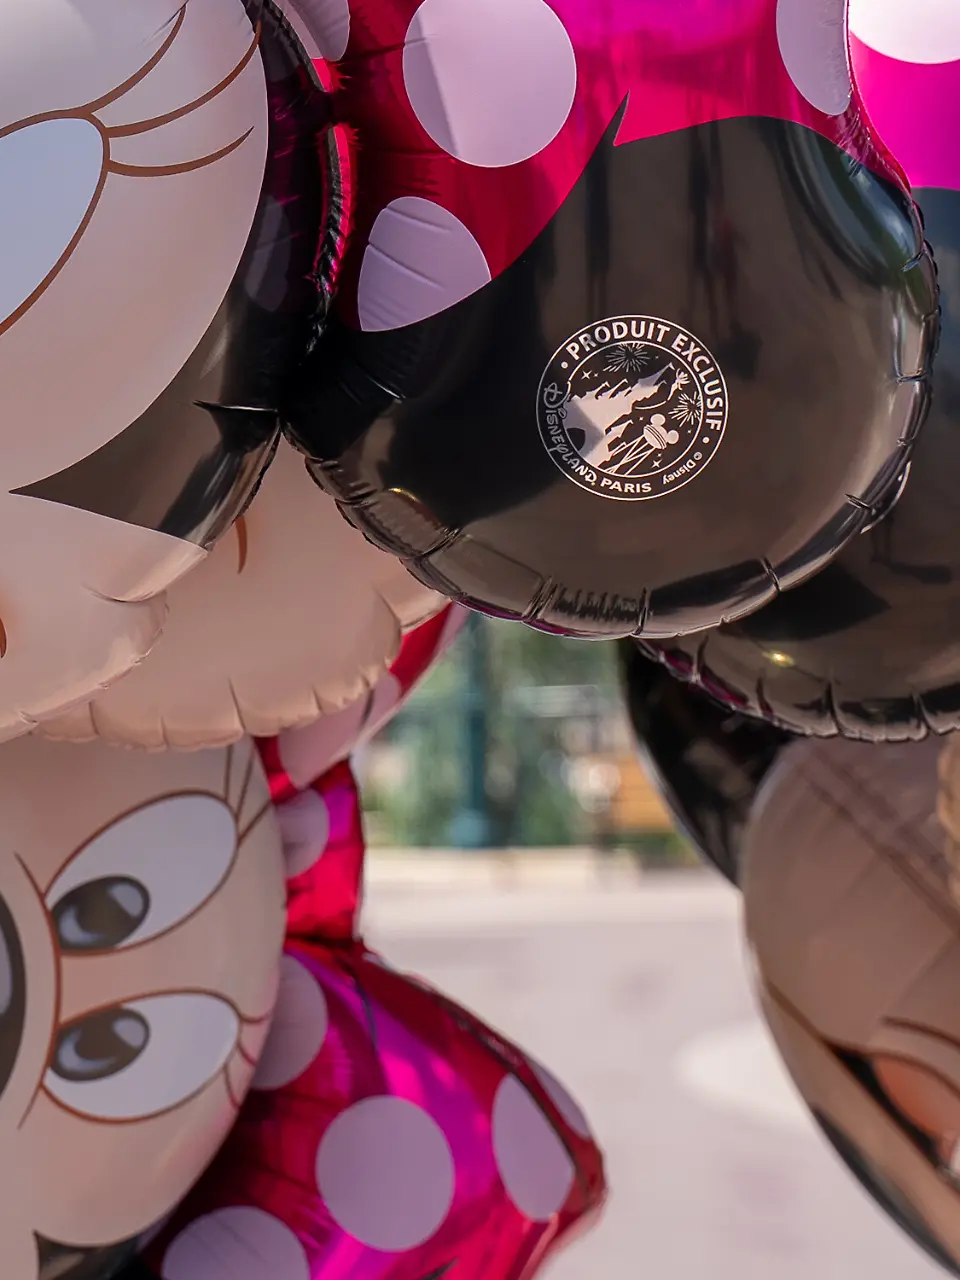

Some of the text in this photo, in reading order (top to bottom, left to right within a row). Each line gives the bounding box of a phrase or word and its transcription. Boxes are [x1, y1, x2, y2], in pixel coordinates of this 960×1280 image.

[566, 320, 722, 431] PRODUIT EXCLUSIF
[600, 477, 652, 493] PARIS
[662, 459, 697, 485] Disney
